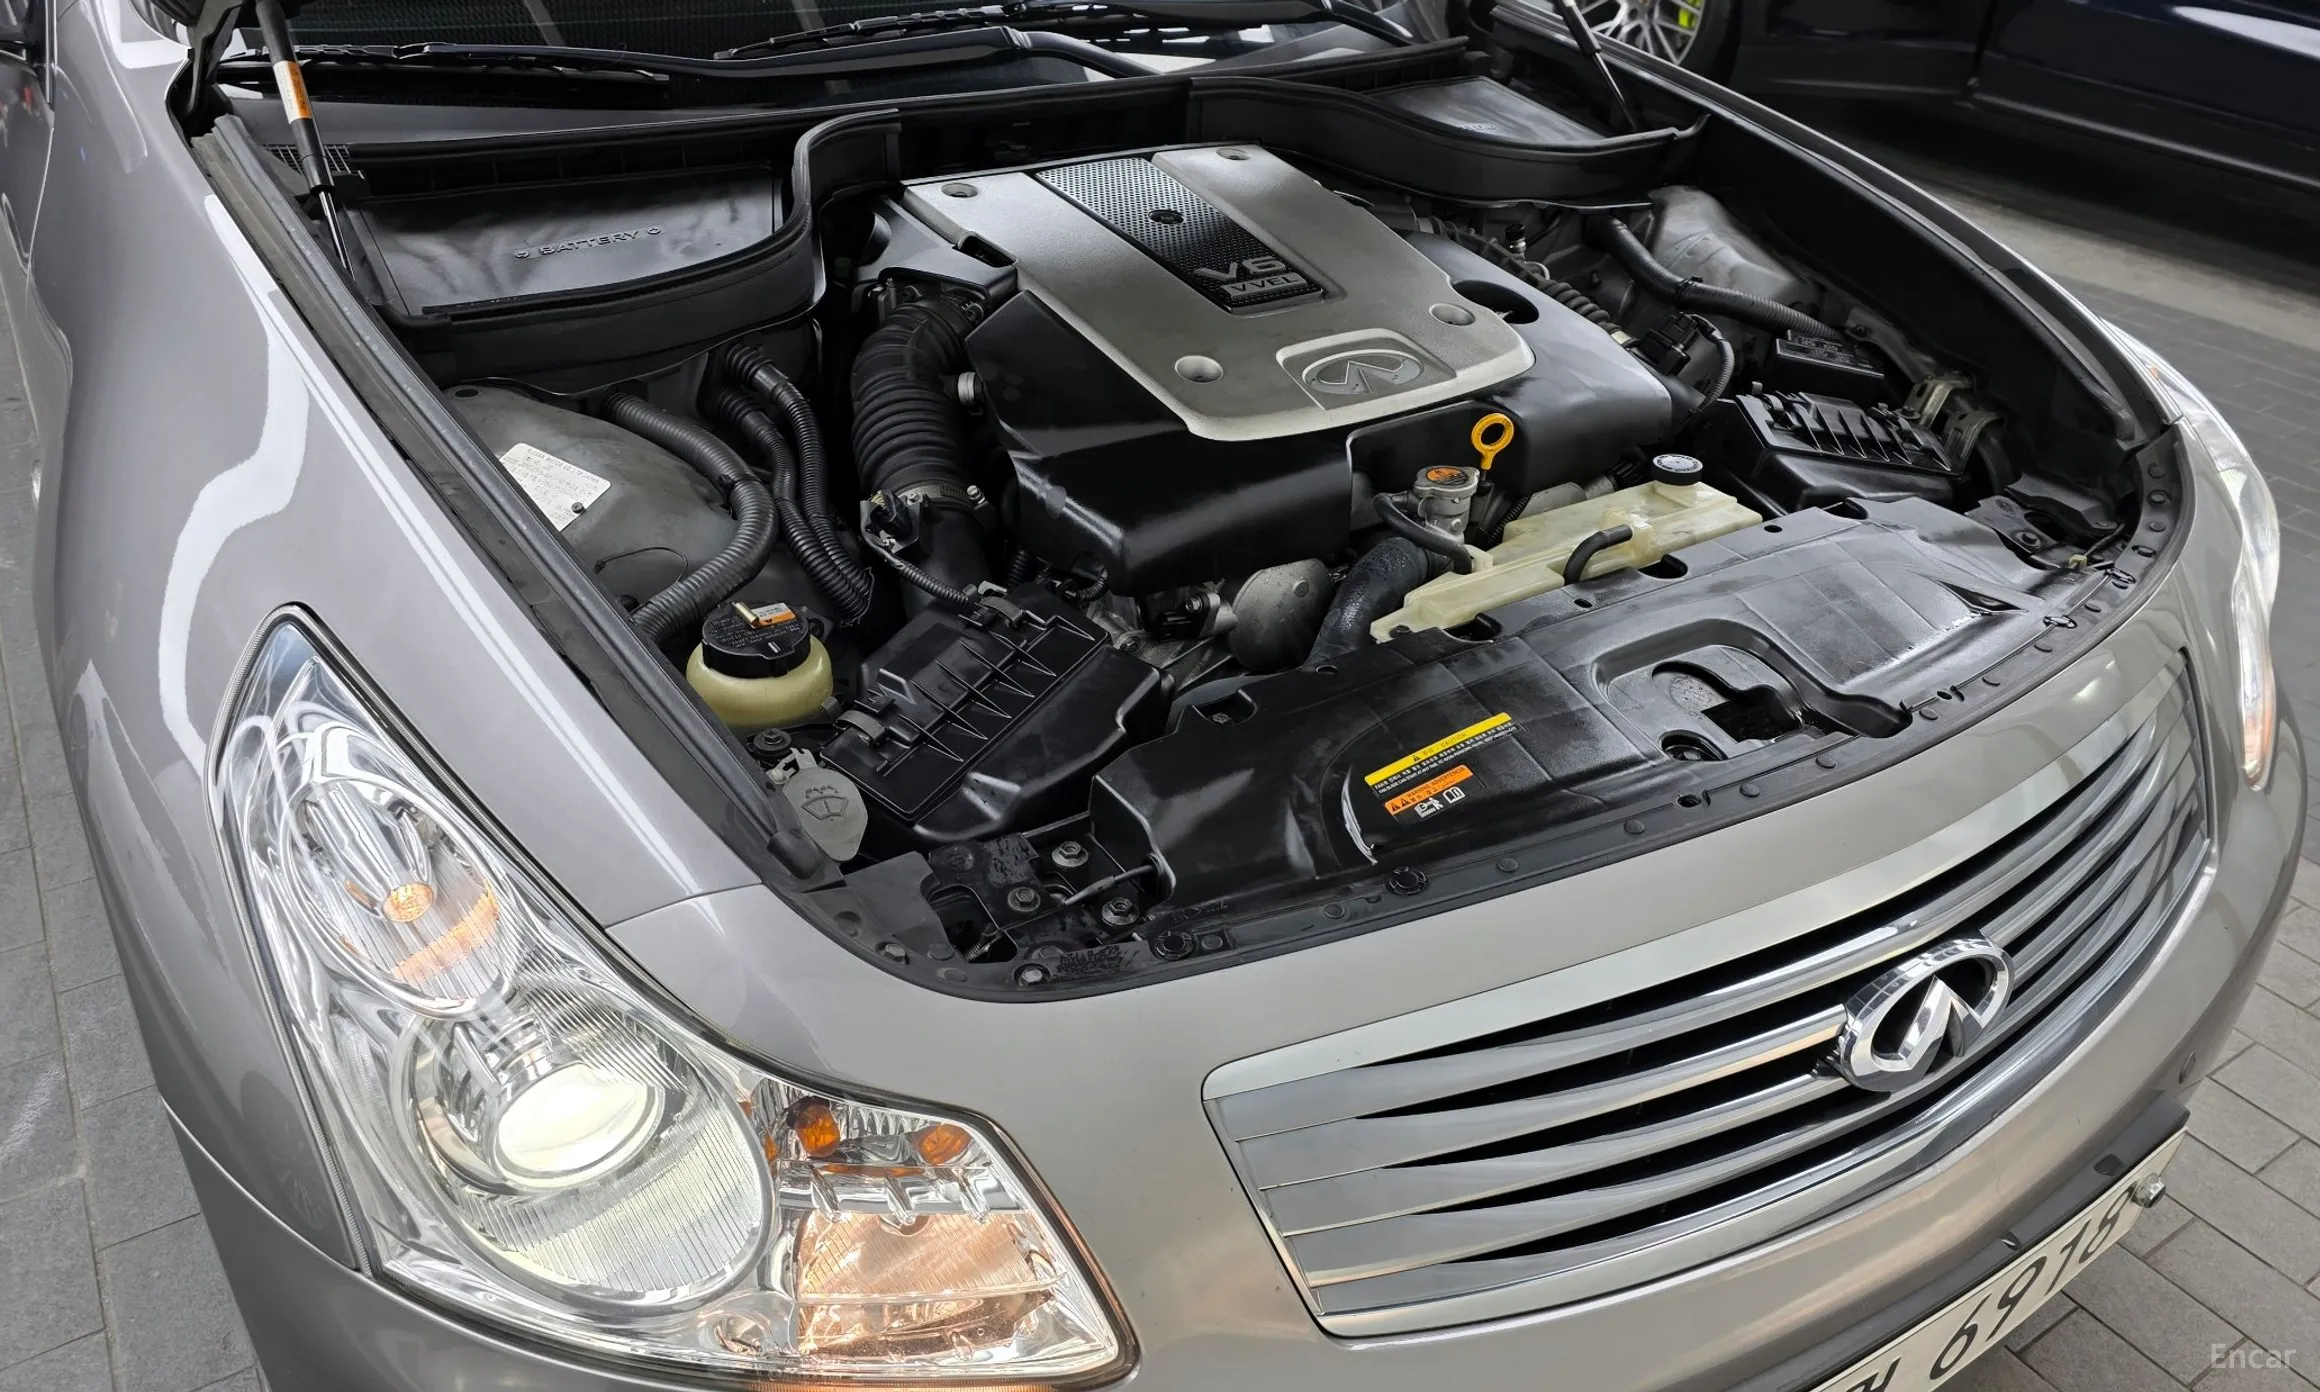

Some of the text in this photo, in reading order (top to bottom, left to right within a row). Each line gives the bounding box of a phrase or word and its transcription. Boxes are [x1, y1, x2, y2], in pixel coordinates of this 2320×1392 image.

[538, 230, 640, 256] BATTERY
[1193, 255, 1287, 283] V6
[1231, 275, 1299, 292] VVEL
[1441, 732, 1467, 748] CAUTION
[1928, 1180, 2139, 1381] 6918
